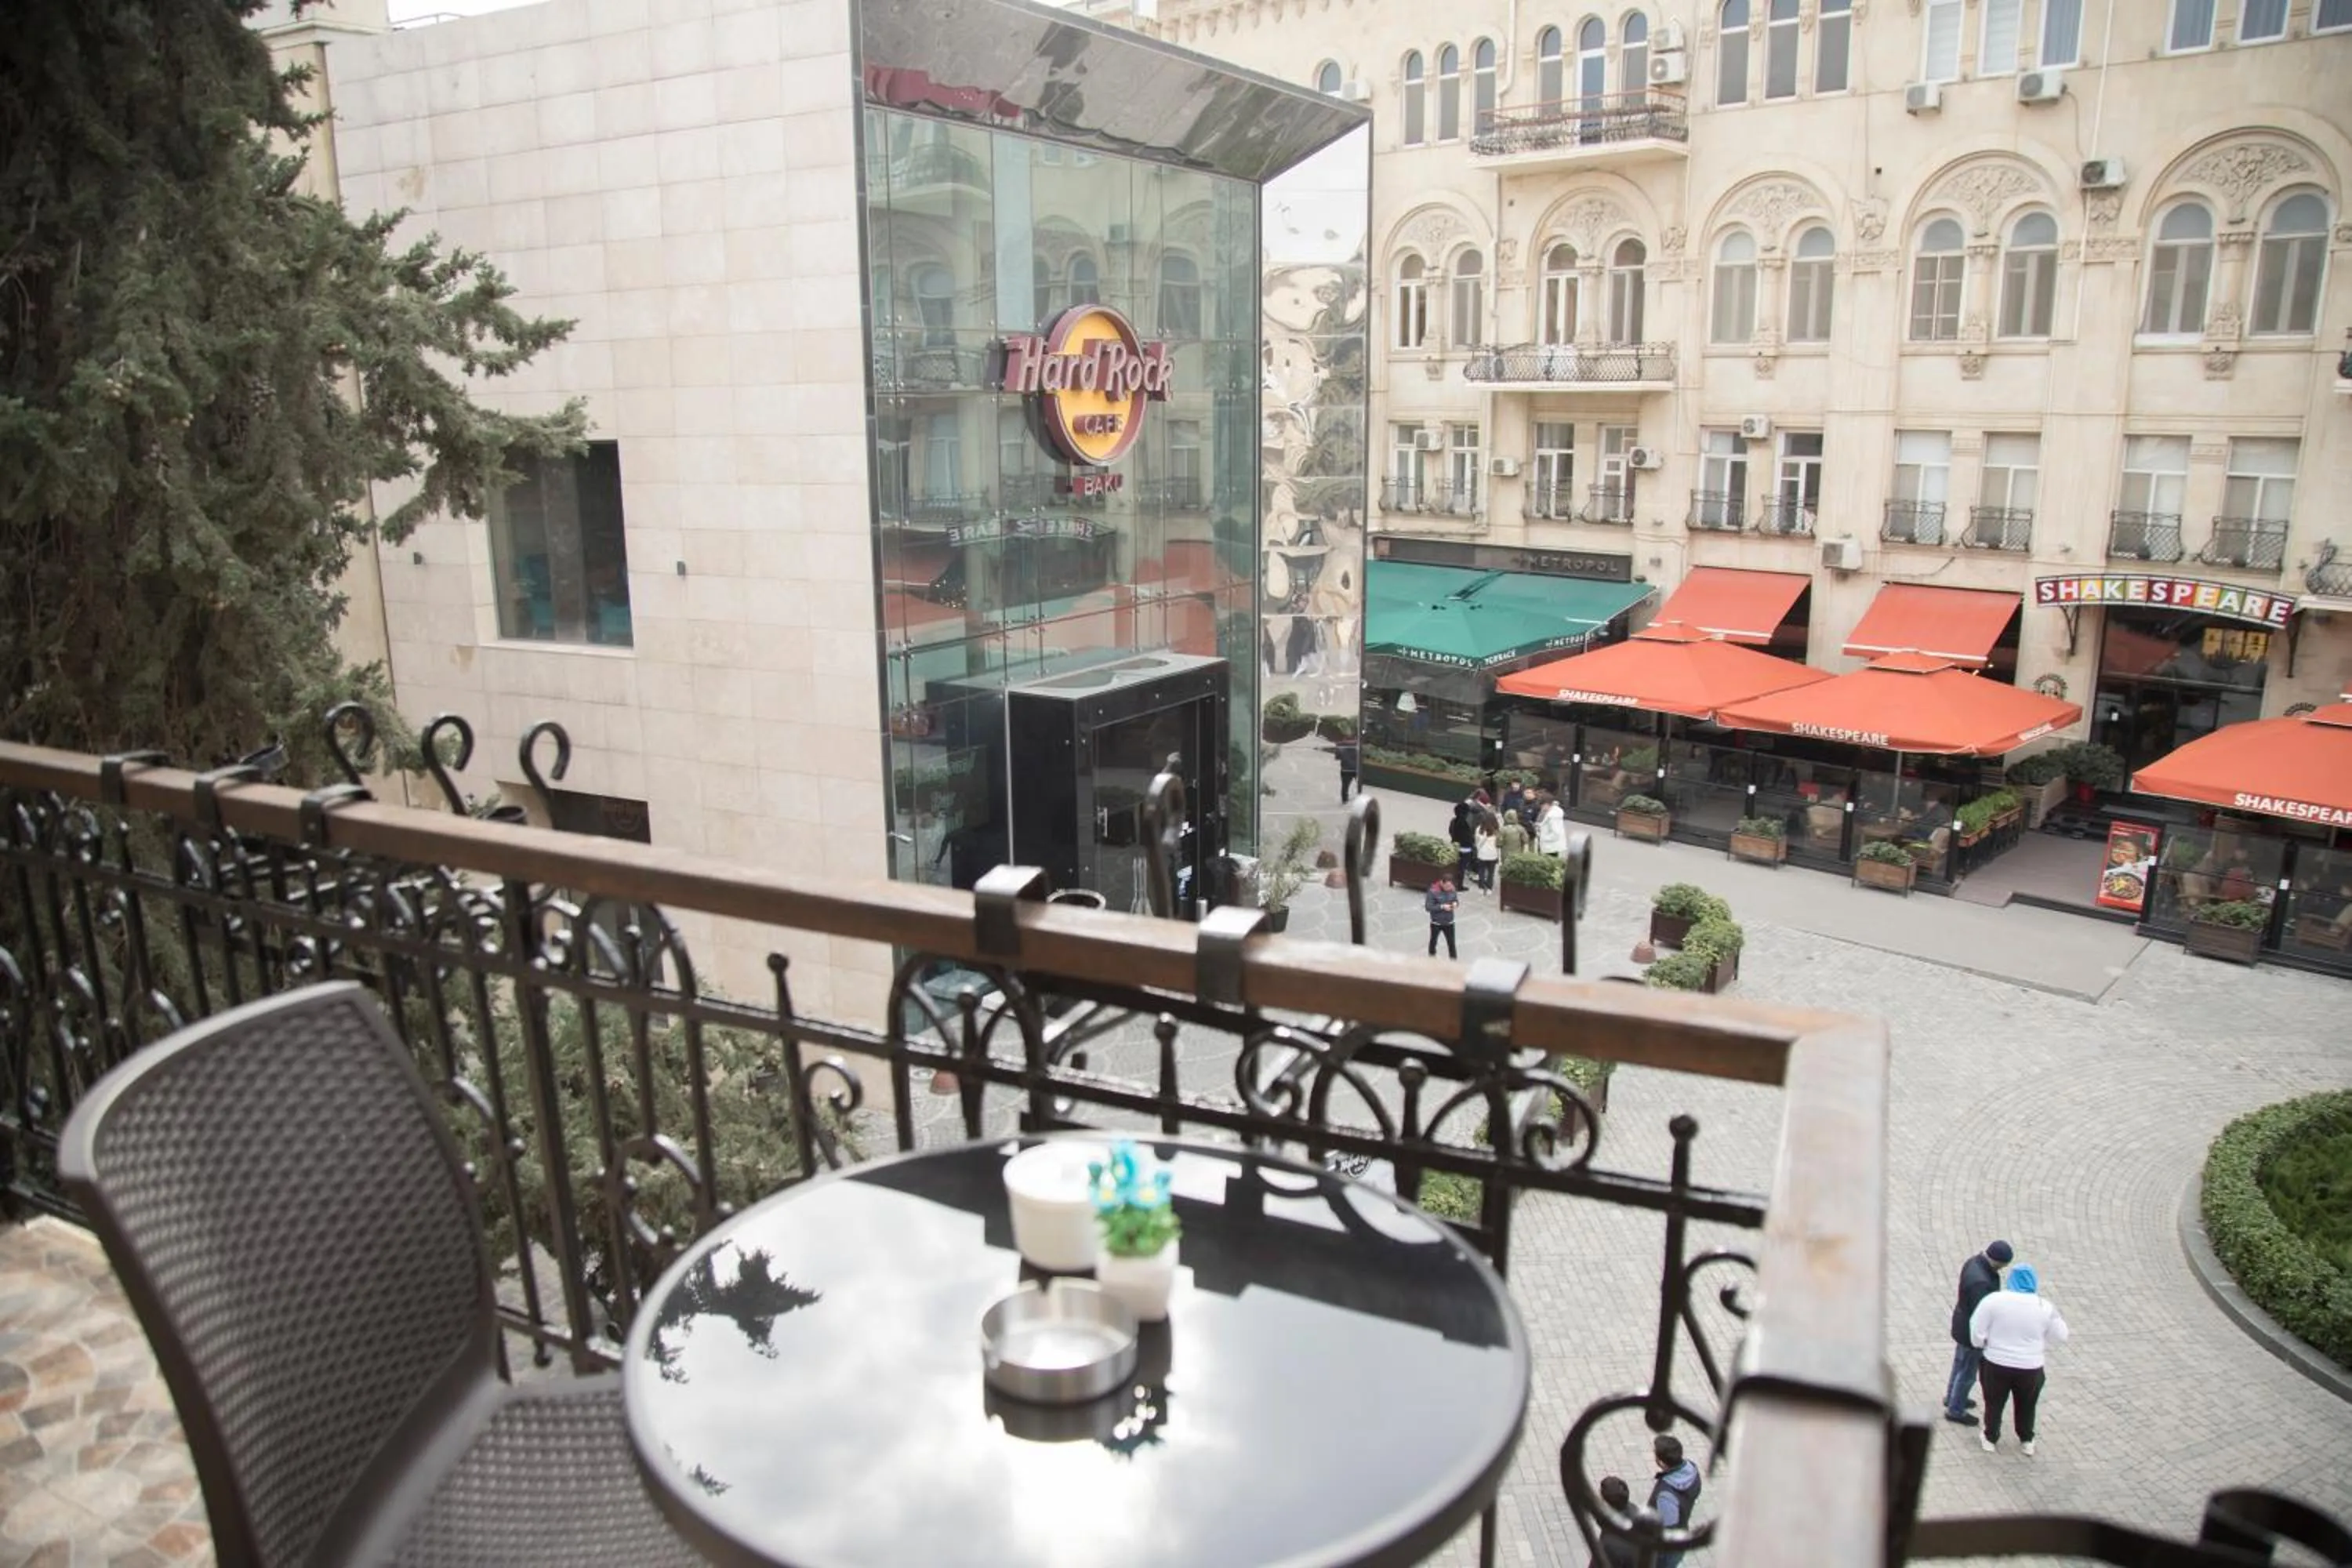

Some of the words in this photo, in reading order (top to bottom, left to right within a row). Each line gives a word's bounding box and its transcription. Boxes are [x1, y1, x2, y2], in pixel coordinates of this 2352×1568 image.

[1005, 336, 1102, 392] Hard
[1105, 339, 1174, 401] Rock
[1084, 474, 1123, 495] BAKU
[1529, 554, 1619, 573] METROPOL
[2039, 578, 2292, 623] SHAKESPEARE
[1410, 649, 1474, 667] METROPOL
[1558, 688, 1639, 706] SHAKESPEARE
[1791, 720, 1889, 746] SHAKESPEARE
